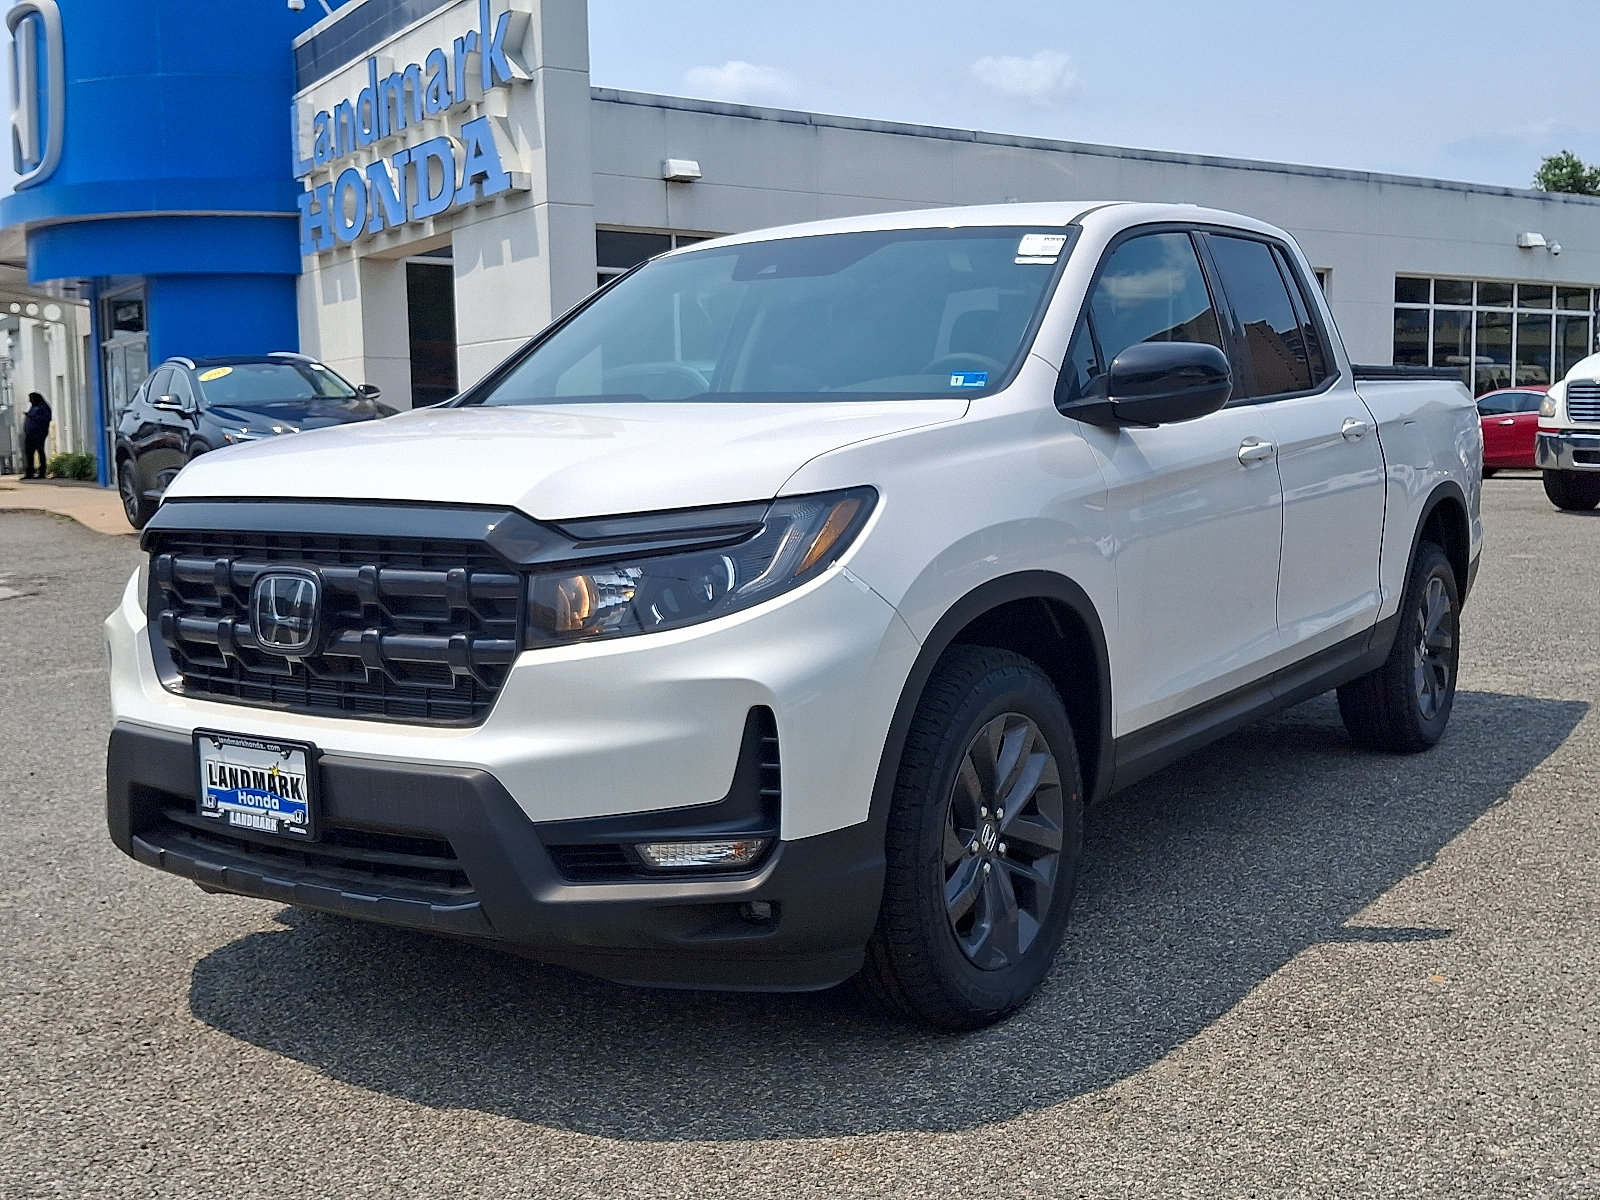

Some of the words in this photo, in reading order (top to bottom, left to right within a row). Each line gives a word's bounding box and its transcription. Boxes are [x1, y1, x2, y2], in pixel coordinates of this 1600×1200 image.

[291, 0, 514, 179] Landmark
[298, 115, 513, 257] HONDA
[208, 761, 303, 801] LANDMARK
[238, 790, 280, 810] Honda
[230, 811, 278, 832] LANDMARK
